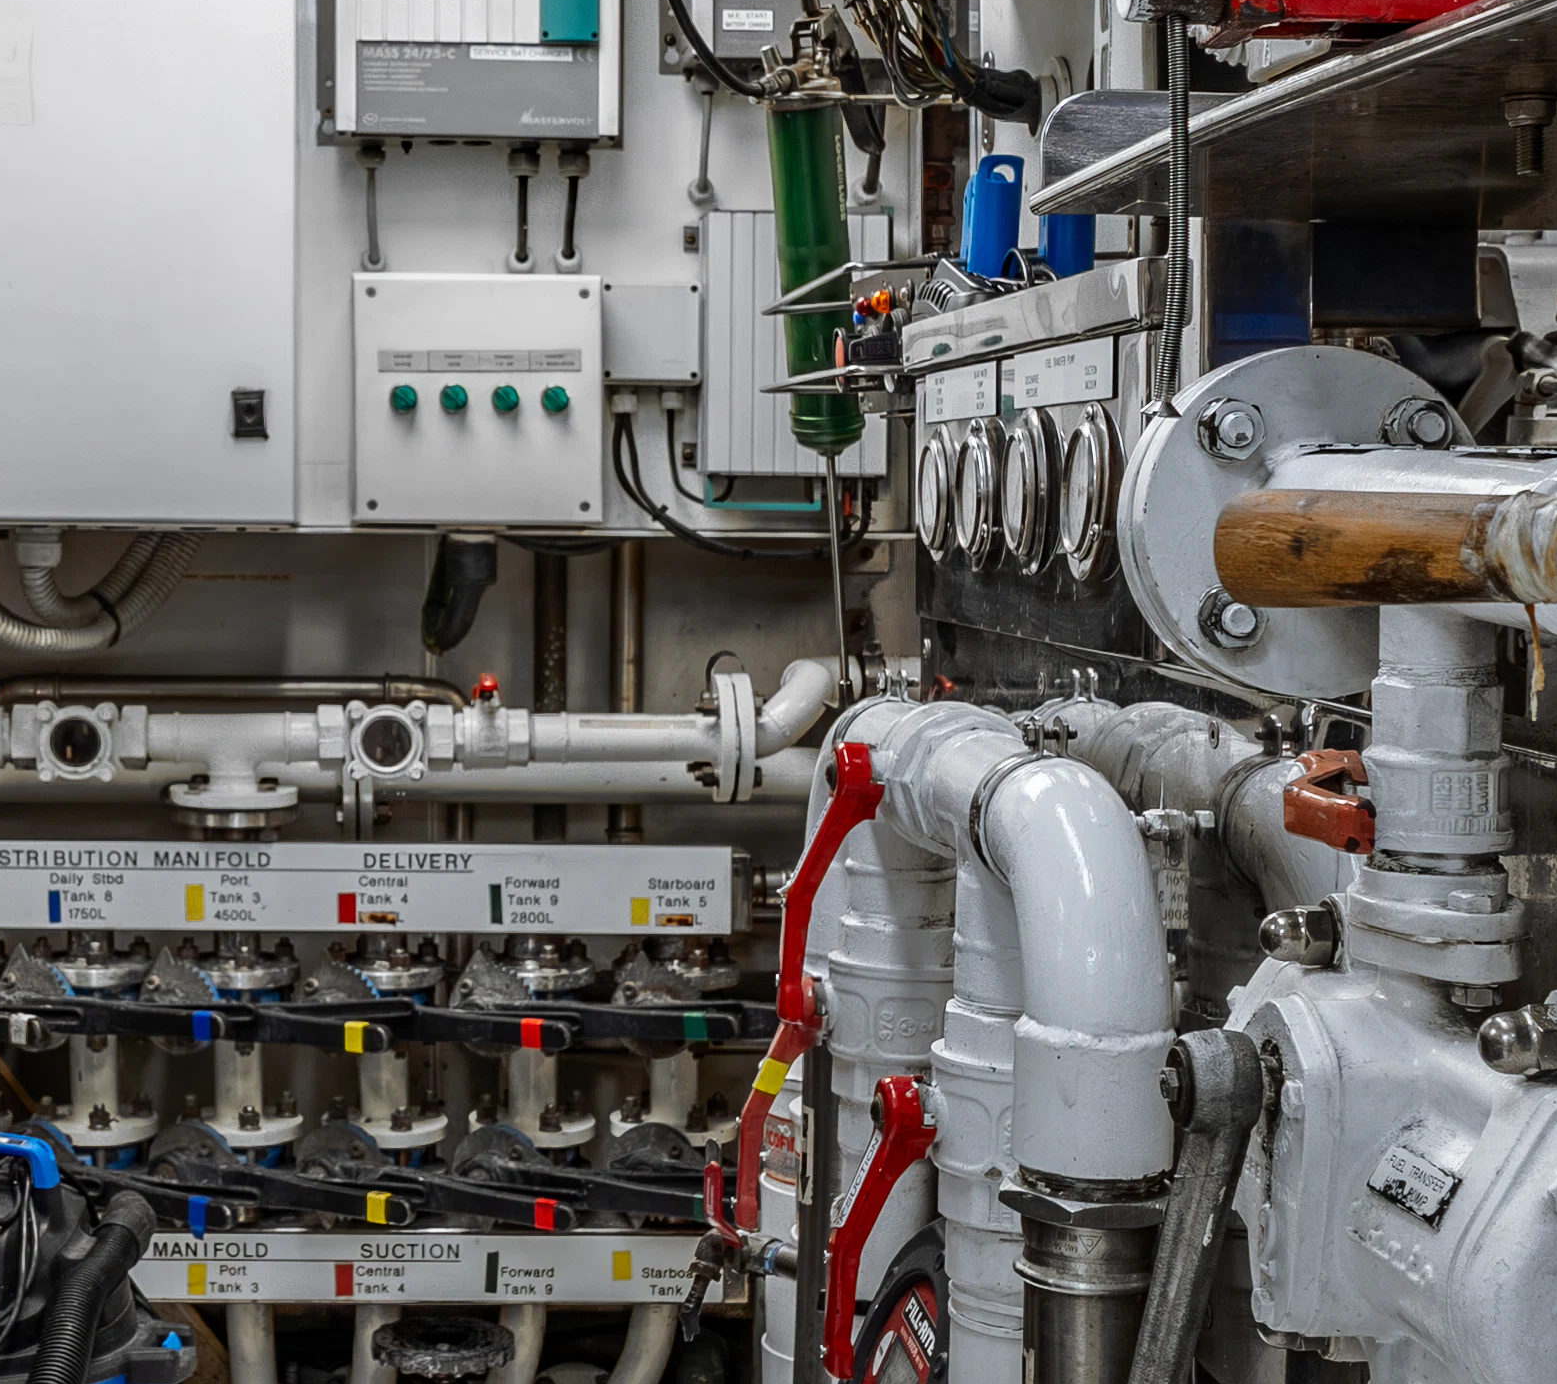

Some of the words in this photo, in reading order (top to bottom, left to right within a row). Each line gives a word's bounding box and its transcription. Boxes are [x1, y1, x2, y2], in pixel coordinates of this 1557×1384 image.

[362, 47, 399, 60] MASS
[154, 851, 271, 867] MANIFOLD
[364, 853, 473, 869] DELIVERY
[50, 873, 84, 886] Daily
[92, 873, 124, 885] Stbd
[220, 875, 248, 886] Port
[358, 876, 408, 887] Central
[505, 877, 560, 889] Forward
[648, 878, 715, 890] Starboard
[62, 891, 95, 901] Tank
[104, 891, 112, 901] 8
[210, 892, 243, 903] Tank
[253, 893, 261, 903] 3
[358, 893, 392, 905] Tank
[400, 894, 408, 905] 4
[508, 895, 540, 906] Tank
[550, 895, 558, 906] 9
[656, 896, 690, 907] Tank
[699, 897, 707, 907] 5
[214, 909, 256, 921] 4500L
[510, 913, 554, 924] 2800L
[153, 1242, 268, 1257] MANIFOLD
[360, 1243, 460, 1259] SUCTION
[220, 1265, 247, 1277] Port
[356, 1266, 405, 1277] Central
[500, 1267, 554, 1279] Forward
[642, 1267, 694, 1279] Starboa
[209, 1282, 243, 1293] Tank
[251, 1283, 259, 1293] 3
[355, 1283, 388, 1294] Tank
[398, 1283, 405, 1294] 4
[504, 1284, 536, 1295] Tank
[545, 1285, 553, 1295] 9
[650, 1285, 683, 1296] Tank
